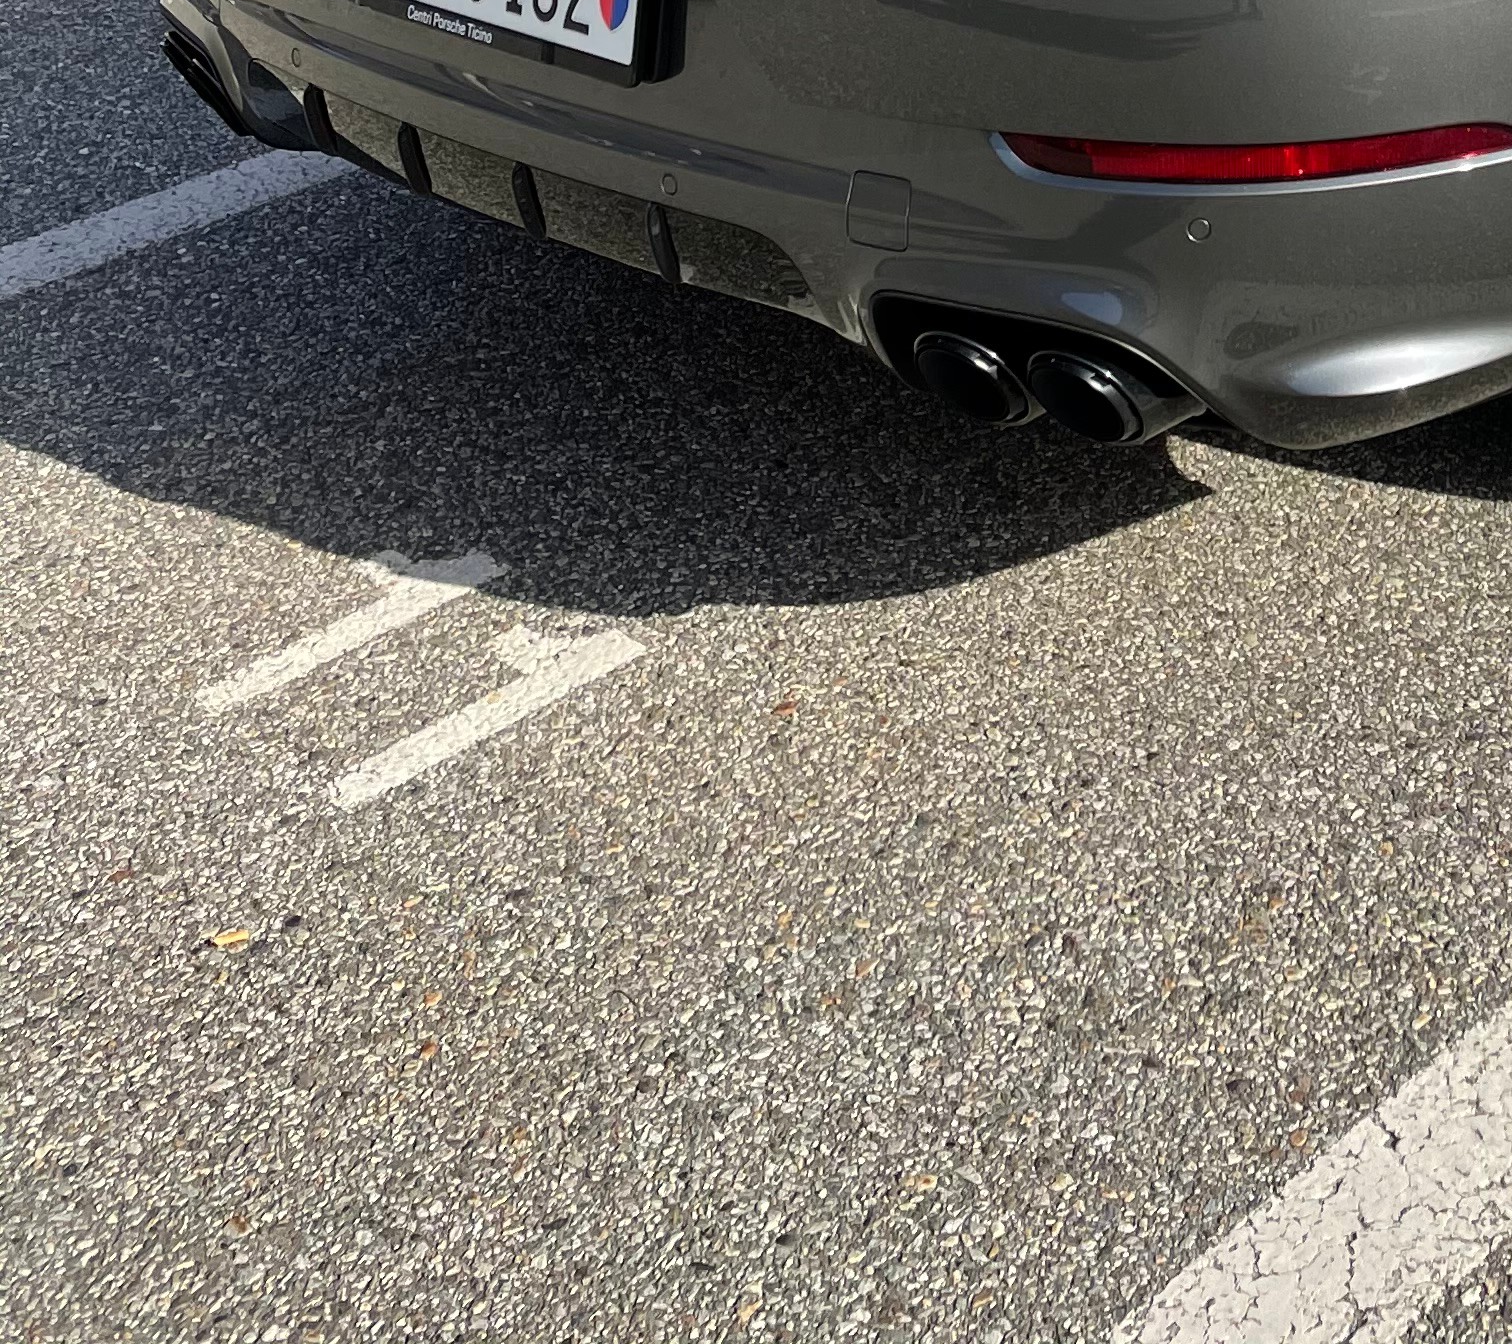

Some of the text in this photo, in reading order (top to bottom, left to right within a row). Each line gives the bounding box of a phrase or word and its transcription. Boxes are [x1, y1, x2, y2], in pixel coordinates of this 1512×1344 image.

[407, 4, 492, 44] Centri Porsche Ticino
